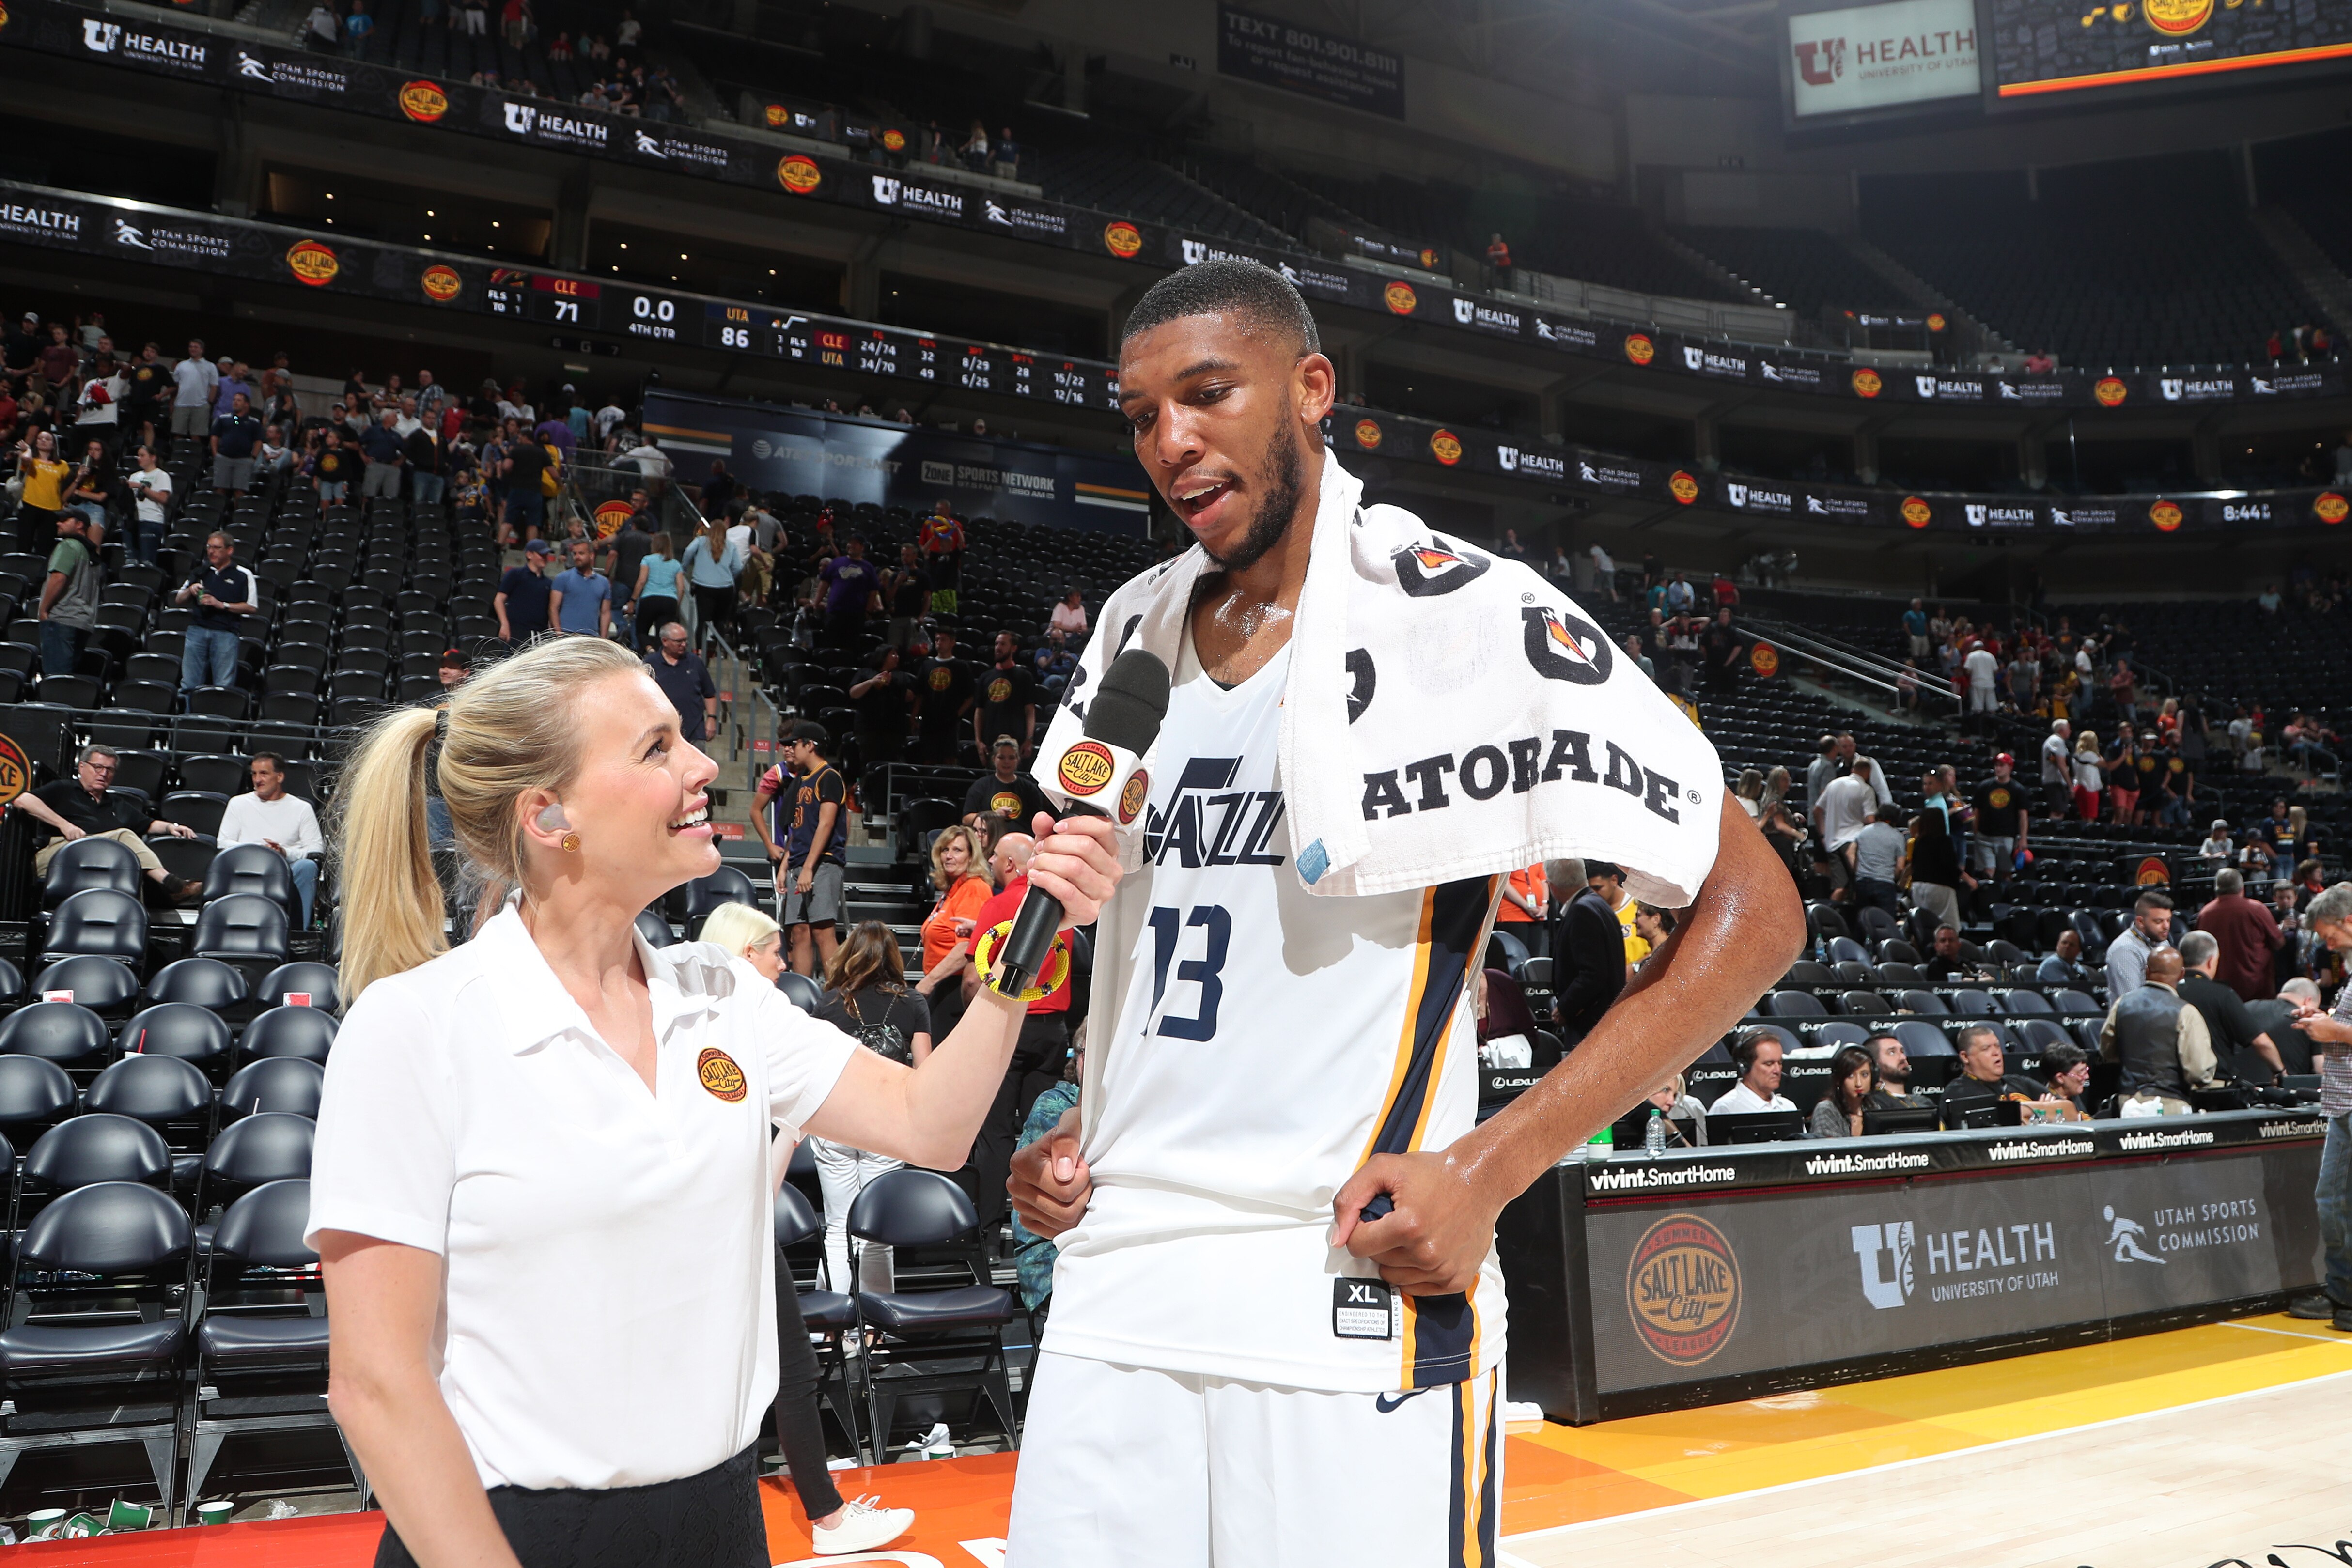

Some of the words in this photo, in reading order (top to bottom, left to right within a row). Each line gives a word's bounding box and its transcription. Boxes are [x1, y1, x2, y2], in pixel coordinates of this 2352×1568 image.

[1225, 12, 1279, 40] TEXT
[125, 32, 206, 62] HEALTH
[1857, 28, 1976, 65] HEALTH
[273, 62, 302, 75] UTAH
[306, 68, 347, 83] SPORTS
[1858, 62, 1925, 80] UNIVERSITY
[1928, 61, 1942, 71] OF
[1947, 57, 1978, 69] UTAH
[539, 114, 607, 141] HEALTH
[903, 186, 963, 211] HEALTH
[0, 203, 80, 232] HEALTH
[1010, 207, 1032, 218] UTAH
[152, 229, 182, 240] UTAH
[187, 233, 230, 248] SPORTS
[488, 289, 508, 301] FLS
[515, 294, 522, 302] 1
[554, 279, 577, 294] CLE
[493, 302, 506, 312] TO
[515, 305, 521, 314] 1
[554, 300, 579, 323] 71
[633, 296, 675, 322] 0.0
[727, 307, 749, 323] UTA
[1476, 307, 1520, 328] HEALTH
[629, 322, 651, 336] 4TH
[653, 325, 675, 339] QTR
[721, 326, 749, 349] 86
[778, 334, 783, 344] 3
[790, 336, 807, 348] FLS
[823, 333, 843, 349] CLE
[860, 340, 897, 357] 24/74
[791, 348, 803, 358] TO
[822, 351, 844, 367] UTA
[921, 350, 935, 363] 32
[860, 357, 896, 374] 34/70
[962, 356, 990, 372] 8/29
[1016, 366, 1030, 378] 28
[1704, 354, 1746, 372] HEALTH
[920, 368, 935, 380] 49
[961, 373, 990, 388] 6/25
[1054, 372, 1085, 387] 15/22
[1016, 383, 1030, 395] 24
[1938, 381, 1982, 393] HEALTH
[2185, 380, 2233, 393] HEALTH
[1054, 388, 1084, 404] 12/16
[815, 450, 902, 474] SPORTSNET
[1520, 453, 1564, 472] HEALTH
[924, 465, 951, 482] ZONE
[957, 465, 998, 483] SPORTS
[1001, 471, 1055, 492] NETWORK
[1008, 487, 1029, 496] 1280
[1031, 490, 1046, 498] AM
[1749, 490, 1791, 506] HEALTH
[1989, 509, 2033, 521] HEALTH
[2223, 504, 2260, 521] 8:44
[1082, 744, 1107, 756] SUMMER
[1065, 754, 1090, 771] SALT
[1086, 756, 1109, 778] LAKE
[1073, 768, 1093, 784] City
[1362, 730, 1679, 825] ATORADE
[1065, 781, 1090, 793] LEAGUE
[1140, 904, 1232, 1042] 13
[703, 1062, 720, 1082] SALT
[720, 1061, 739, 1079] LAKE
[1704, 1071, 1738, 1079] LEXUS
[1801, 1067, 1832, 1075] LEXUS
[718, 1077, 736, 1088] City
[2259, 1120, 2330, 1138] vivint.SmartHo
[2119, 1129, 2214, 1150] vivint.SmartHome
[1988, 1138, 2094, 1161] vivint.SmartHome
[1806, 1151, 1929, 1175] vivint.SmartHome
[1590, 1165, 1736, 1191] vivint.SmartHome
[2154, 1206, 2195, 1227] UTAH
[2202, 1198, 2257, 1221] SPORTS
[1654, 1226, 1708, 1246] SUMMER
[2158, 1222, 2259, 1252] COMMISSION
[1926, 1221, 2056, 1275] HEALTH
[1640, 1254, 1682, 1302] SALT
[1682, 1253, 1728, 1296] LAKE
[1348, 1285, 1378, 1303] XL
[1932, 1278, 2004, 1303] UNIVERSITY
[2007, 1275, 2024, 1293] OF
[2026, 1271, 2059, 1289] UTAH
[1667, 1293, 1709, 1325] City
[1663, 1334, 1712, 1352] LEAGUE
